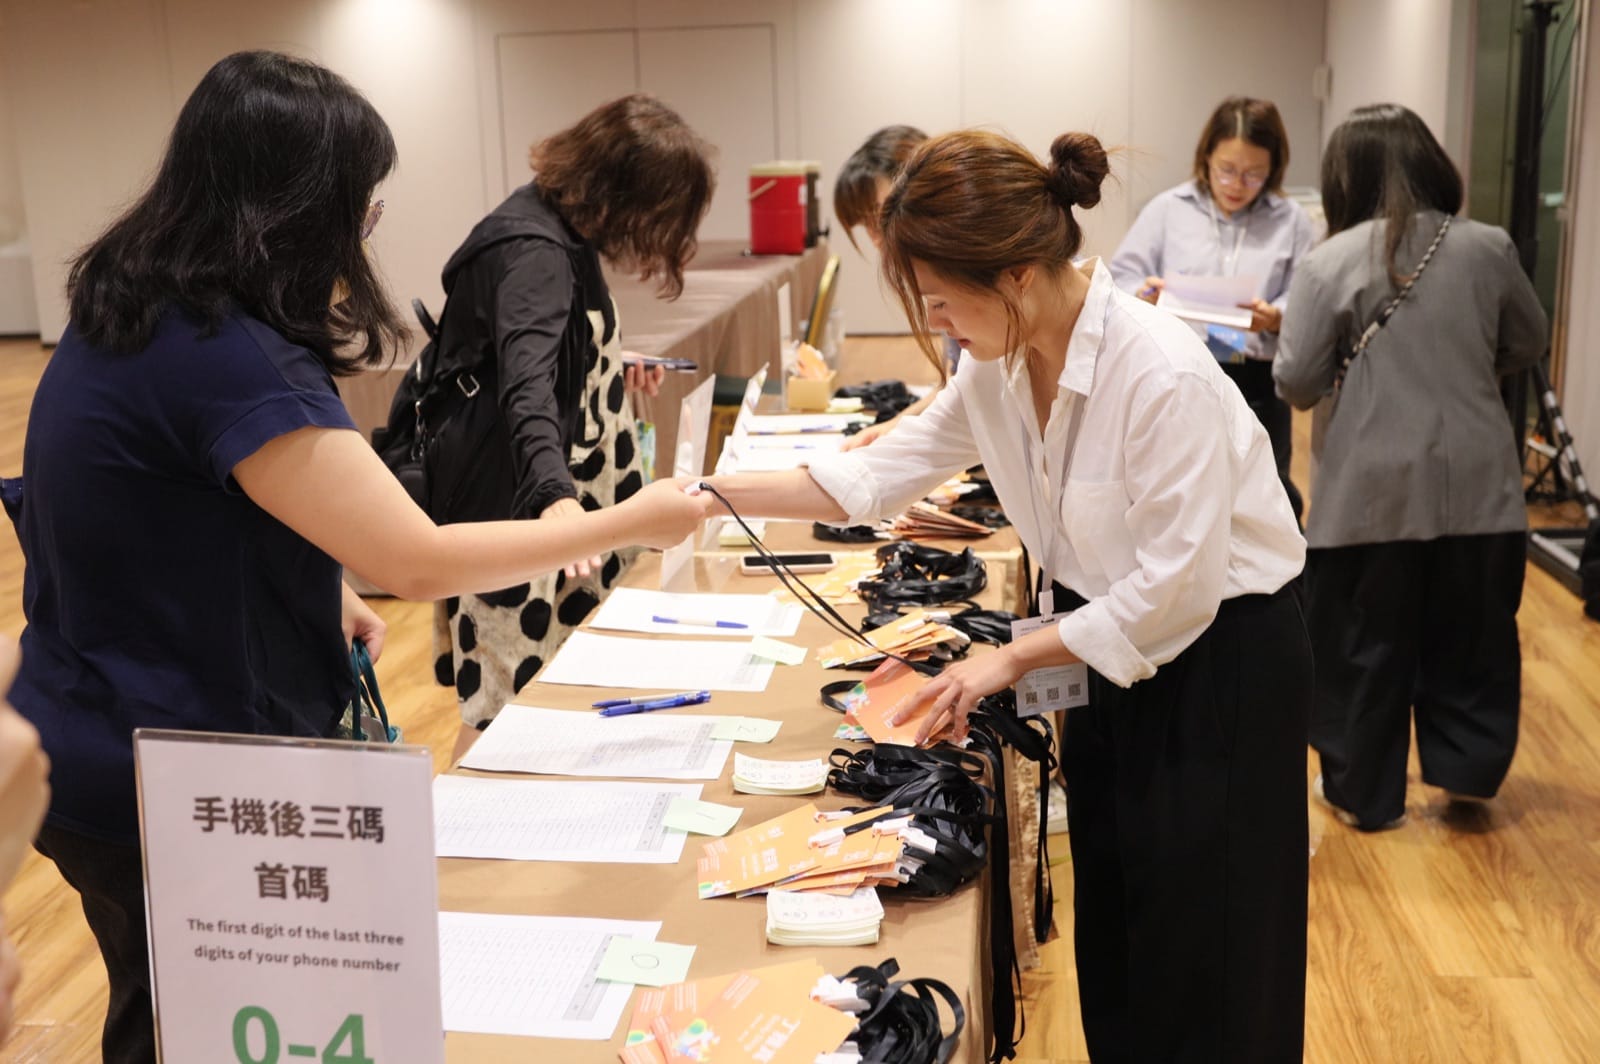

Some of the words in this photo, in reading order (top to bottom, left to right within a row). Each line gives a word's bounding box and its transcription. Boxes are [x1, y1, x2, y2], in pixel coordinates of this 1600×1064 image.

[193, 796, 384, 844] 手機後三碼
[254, 862, 329, 902] 首碼
[187, 919, 214, 932] The
[217, 920, 246, 935] first
[251, 923, 283, 938] digit
[288, 926, 303, 937] of
[306, 926, 330, 940] the
[334, 928, 360, 942] last
[364, 931, 404, 945] three
[194, 945, 234, 961] digits
[238, 949, 252, 961] of
[256, 951, 289, 965] your
[292, 953, 338, 968] phone
[342, 957, 401, 972] number
